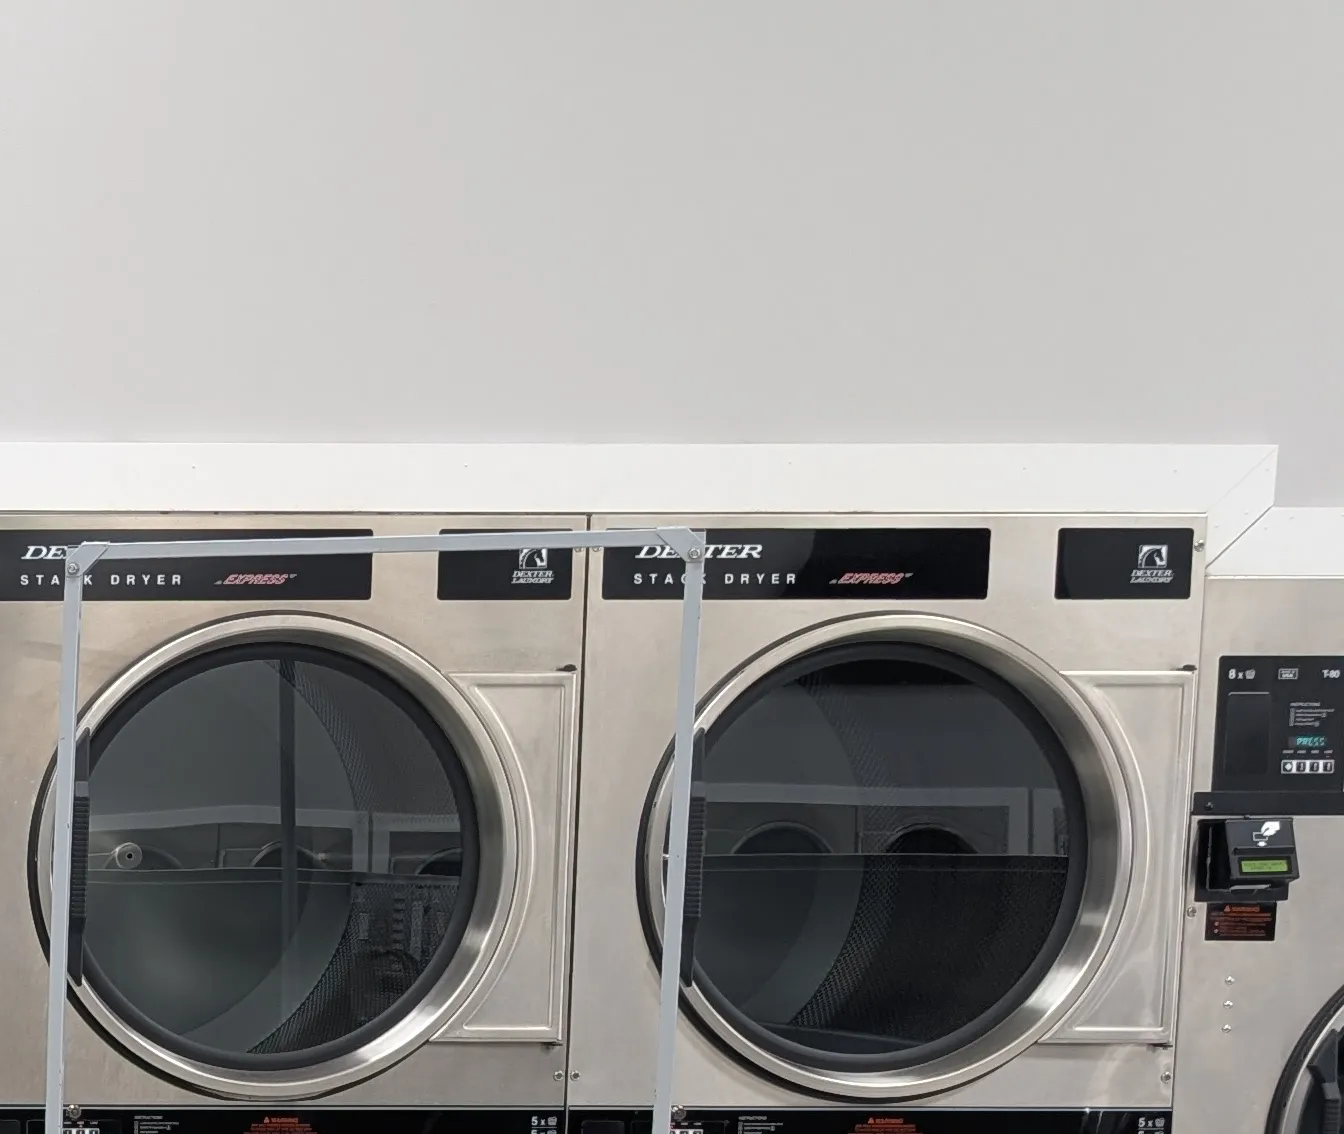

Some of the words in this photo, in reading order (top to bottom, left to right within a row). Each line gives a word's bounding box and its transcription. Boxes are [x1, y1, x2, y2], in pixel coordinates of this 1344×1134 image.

[634, 545, 763, 559] DETER
[20, 574, 93, 586] STAK
[110, 574, 182, 586] DRYER
[221, 573, 290, 585] EXPRESS
[724, 573, 796, 585] DRYER
[836, 573, 906, 585] EXPRESS
[1228, 668, 1237, 680] 8
[531, 1116, 538, 1126] 5
[1138, 1118, 1146, 1128] 5
